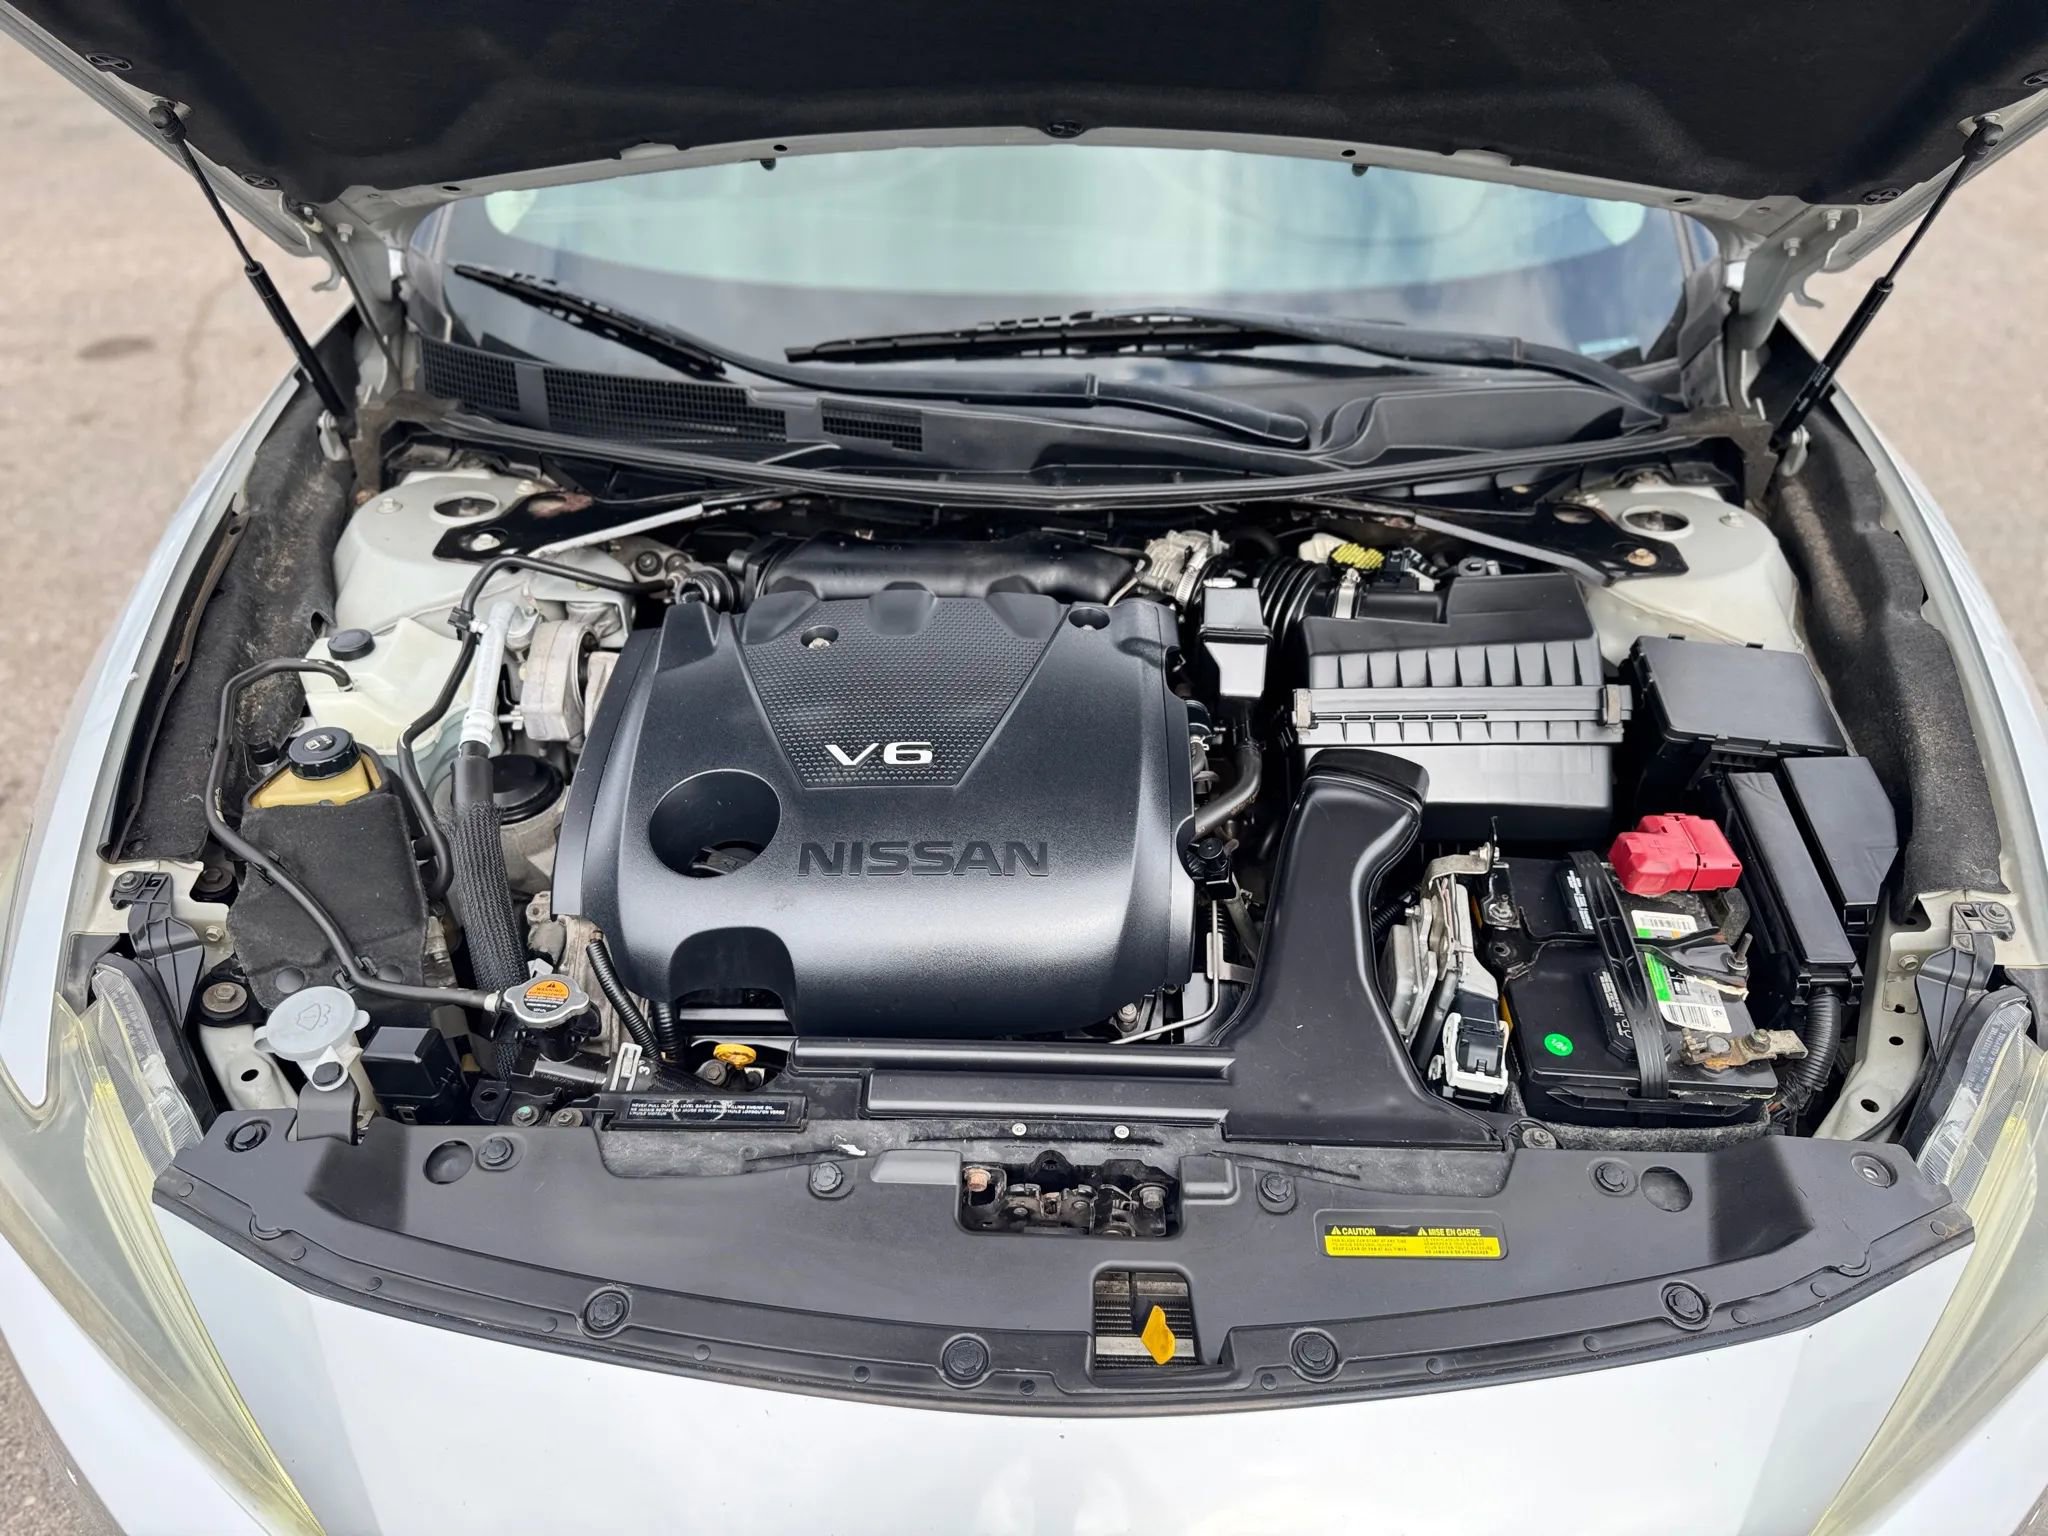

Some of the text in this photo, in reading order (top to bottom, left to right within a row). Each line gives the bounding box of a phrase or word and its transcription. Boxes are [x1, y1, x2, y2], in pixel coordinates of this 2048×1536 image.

[825, 742, 934, 768] V6
[798, 841, 1049, 877] NISSAN
[1341, 1227, 1377, 1236] CAUTION
[1427, 1228, 1482, 1237] MISE EN GARDE
